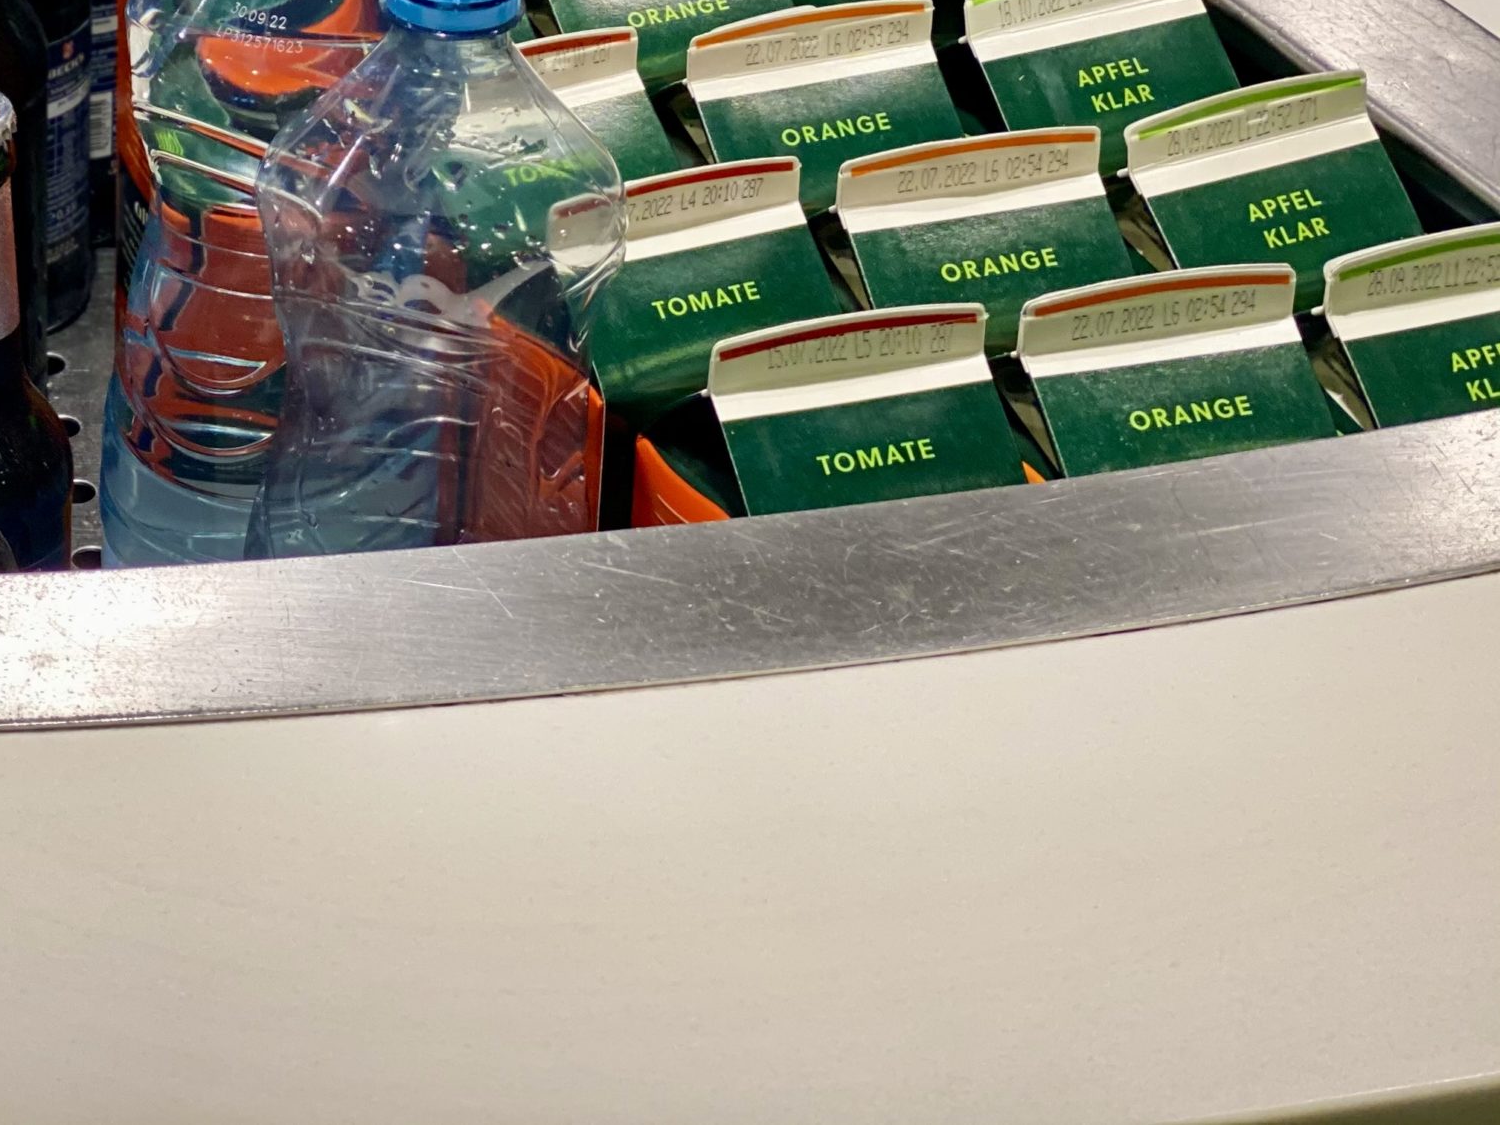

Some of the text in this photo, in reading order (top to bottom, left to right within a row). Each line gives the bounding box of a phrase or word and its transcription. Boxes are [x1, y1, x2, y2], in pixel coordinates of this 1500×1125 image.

[216, 25, 304, 53] LP312571623
[745, 35, 819, 66] 22.07.2022
[827, 32, 841, 56] L6
[1078, 57, 1149, 88] APFEL
[1090, 84, 1155, 113] KLAR
[781, 112, 891, 146] ORANGE
[897, 161, 977, 194] 22.07.2022
[984, 159, 999, 184] L6
[1005, 153, 1042, 180] 02:54
[628, 177, 764, 222] 7.2022 L4 20:10 287
[1249, 189, 1323, 223] APFEL
[1263, 217, 1330, 249] KLAR
[941, 247, 1059, 282] ORANGE
[651, 281, 761, 320] TOMATE
[1071, 304, 1155, 341] 22.07.2022
[1163, 300, 1181, 326] L6
[1185, 293, 1226, 323] 02:54
[1466, 377, 1500, 402] KL
[1129, 395, 1253, 431] ORANGE
[816, 438, 936, 475] TOMATE
